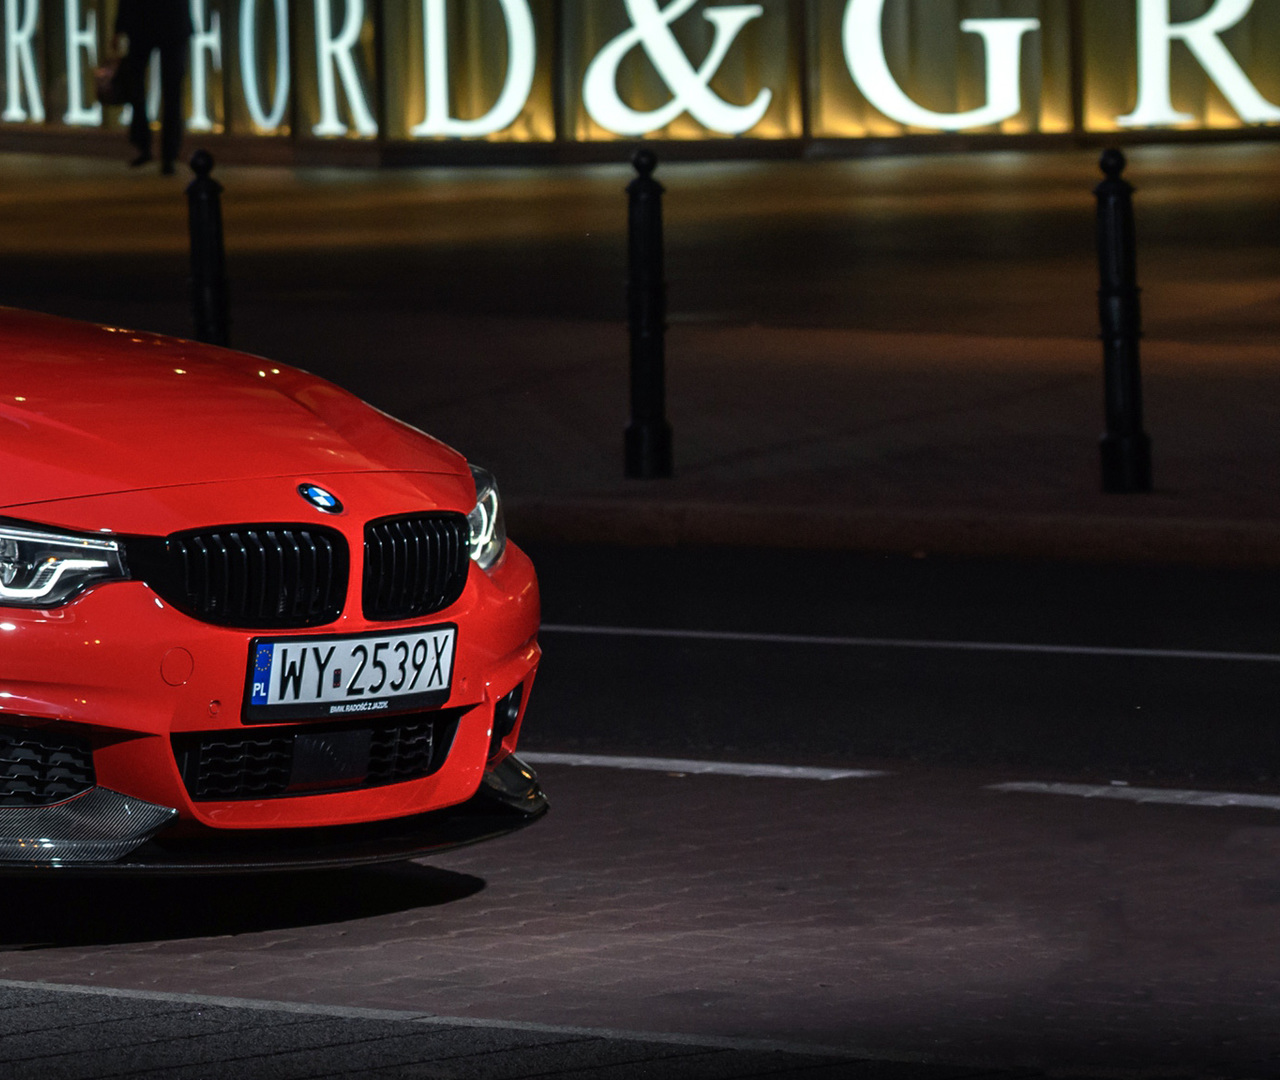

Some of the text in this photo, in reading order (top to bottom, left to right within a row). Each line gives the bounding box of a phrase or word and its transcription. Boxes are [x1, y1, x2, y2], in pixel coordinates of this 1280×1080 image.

[278, 635, 449, 700] WY 2539X
[252, 683, 267, 697] PL
